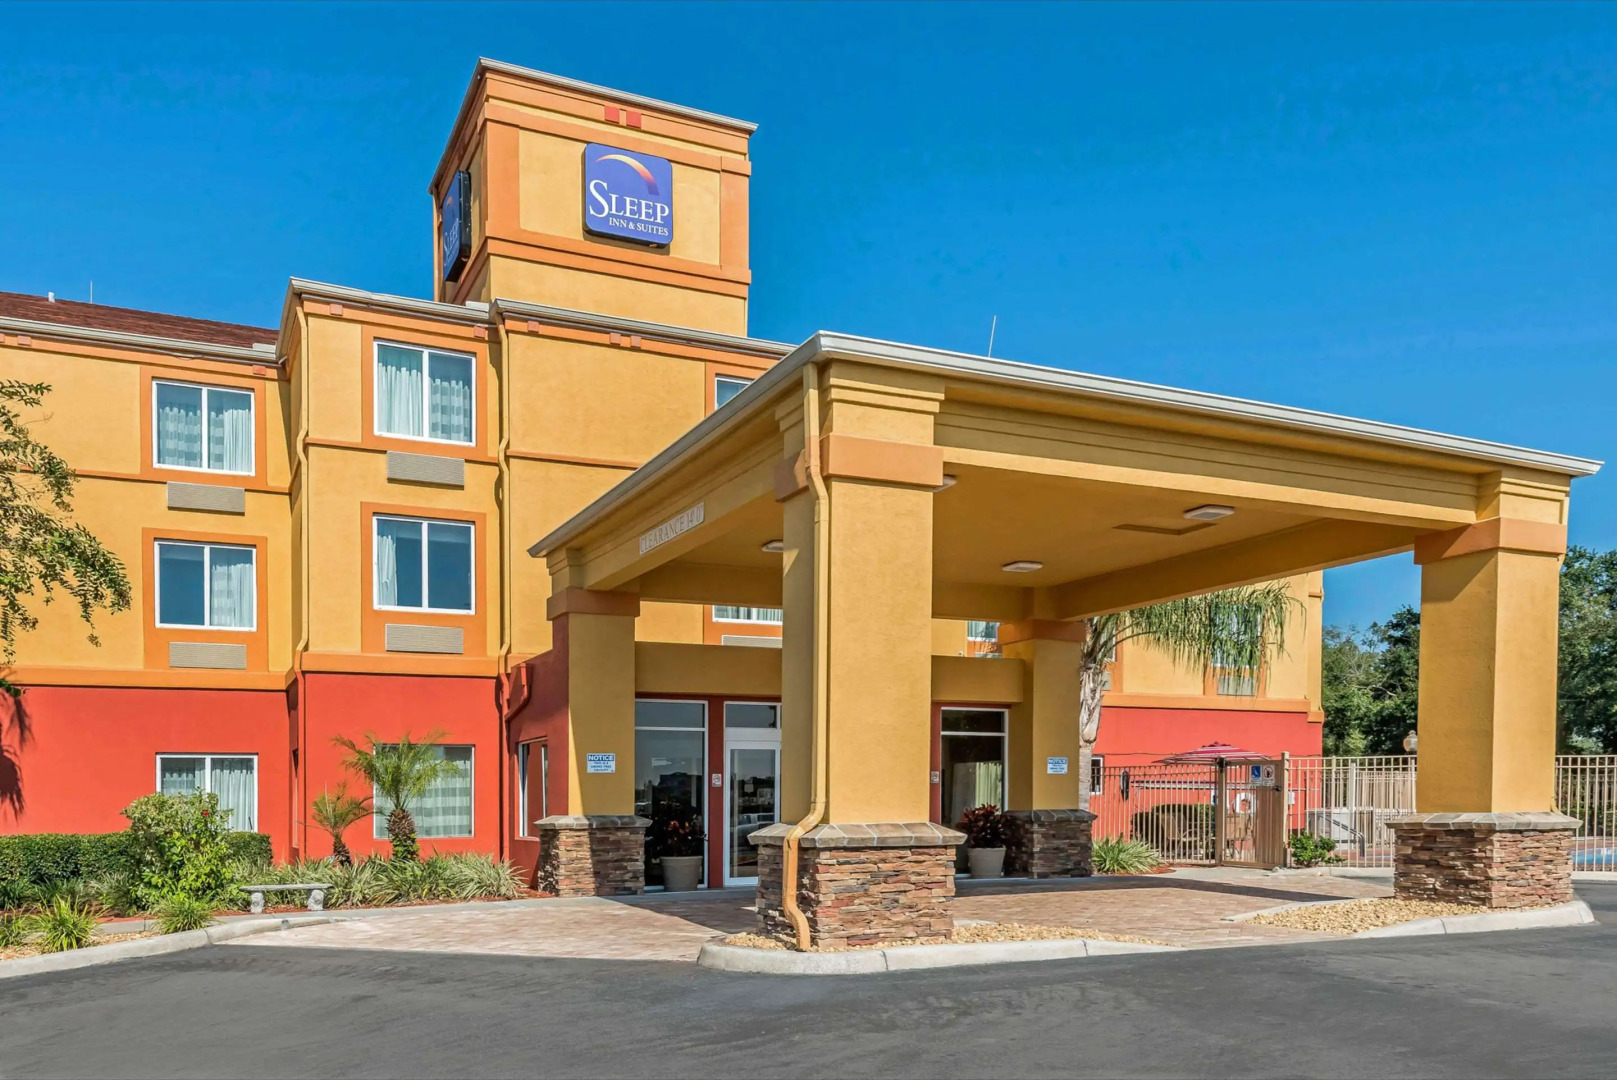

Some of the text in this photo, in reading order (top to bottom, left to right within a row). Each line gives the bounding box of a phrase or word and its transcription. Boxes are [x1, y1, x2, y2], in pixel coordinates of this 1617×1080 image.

[589, 179, 669, 224] SLEEP
[608, 217, 669, 236] INN & SUITES
[640, 515, 684, 553] CLEARANCE
